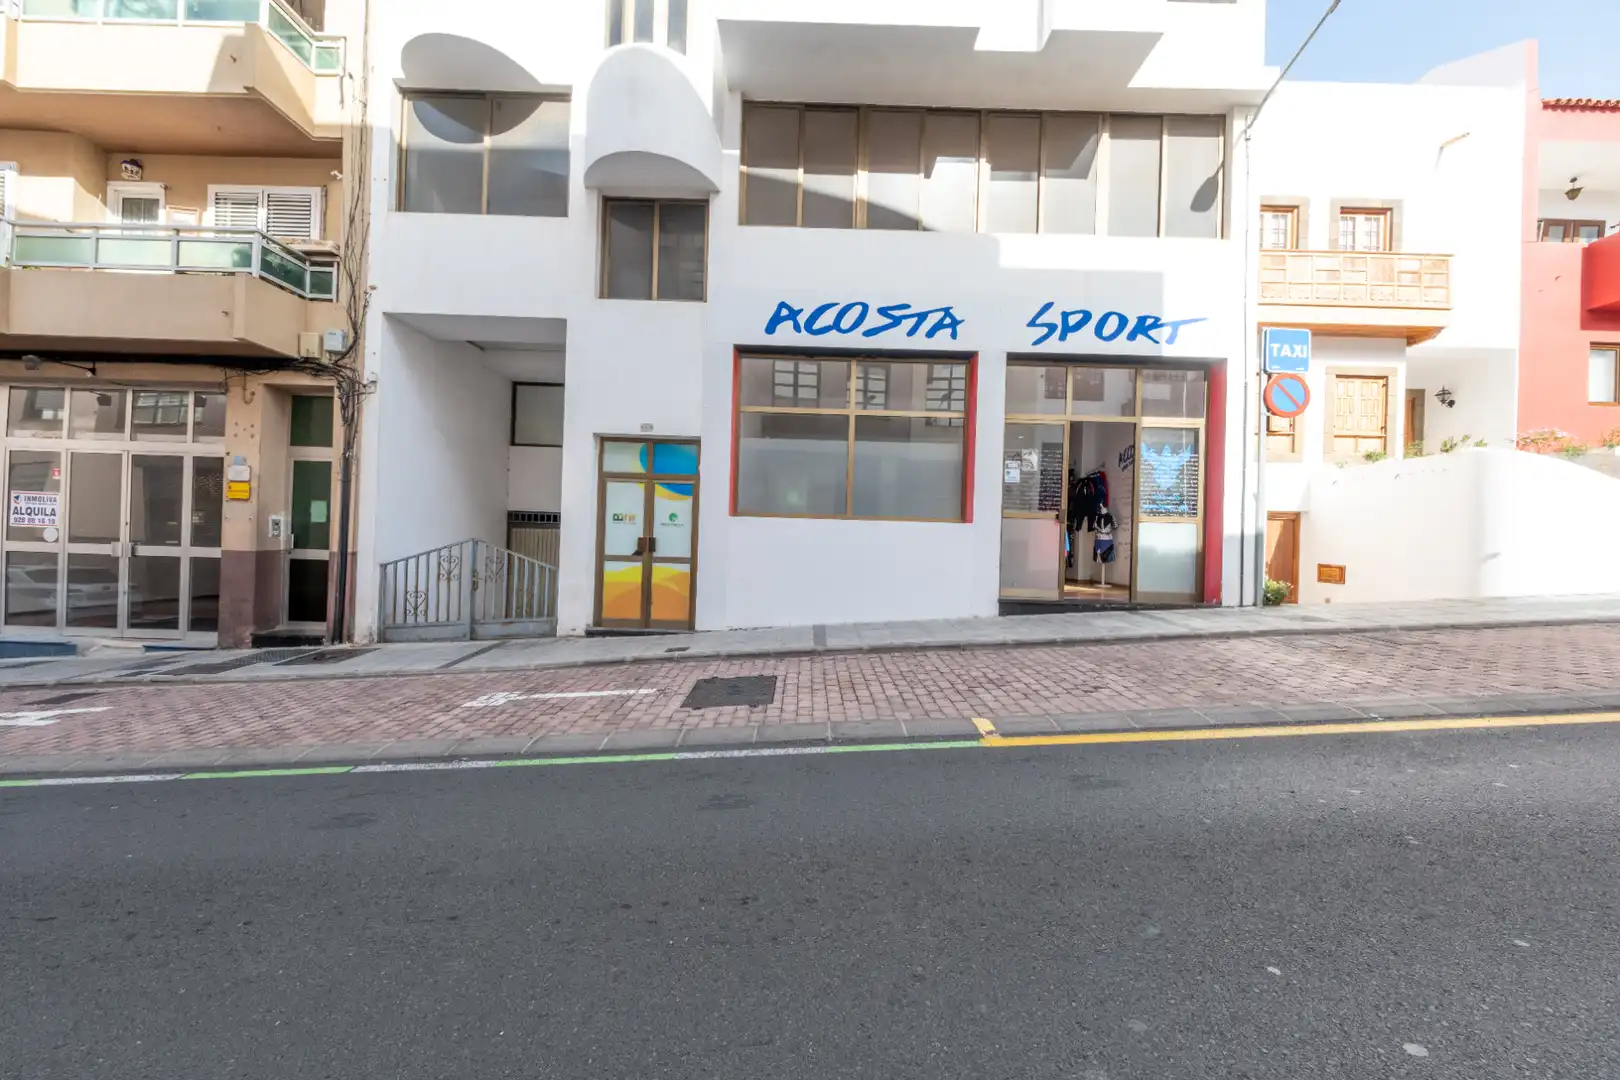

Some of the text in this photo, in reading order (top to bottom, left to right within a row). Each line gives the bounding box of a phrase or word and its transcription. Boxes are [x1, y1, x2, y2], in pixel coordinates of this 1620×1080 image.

[764, 300, 1207, 346] ACOSTA SPORT
[1270, 343, 1307, 358] TAXI
[12, 506, 57, 517] ALQUILA
